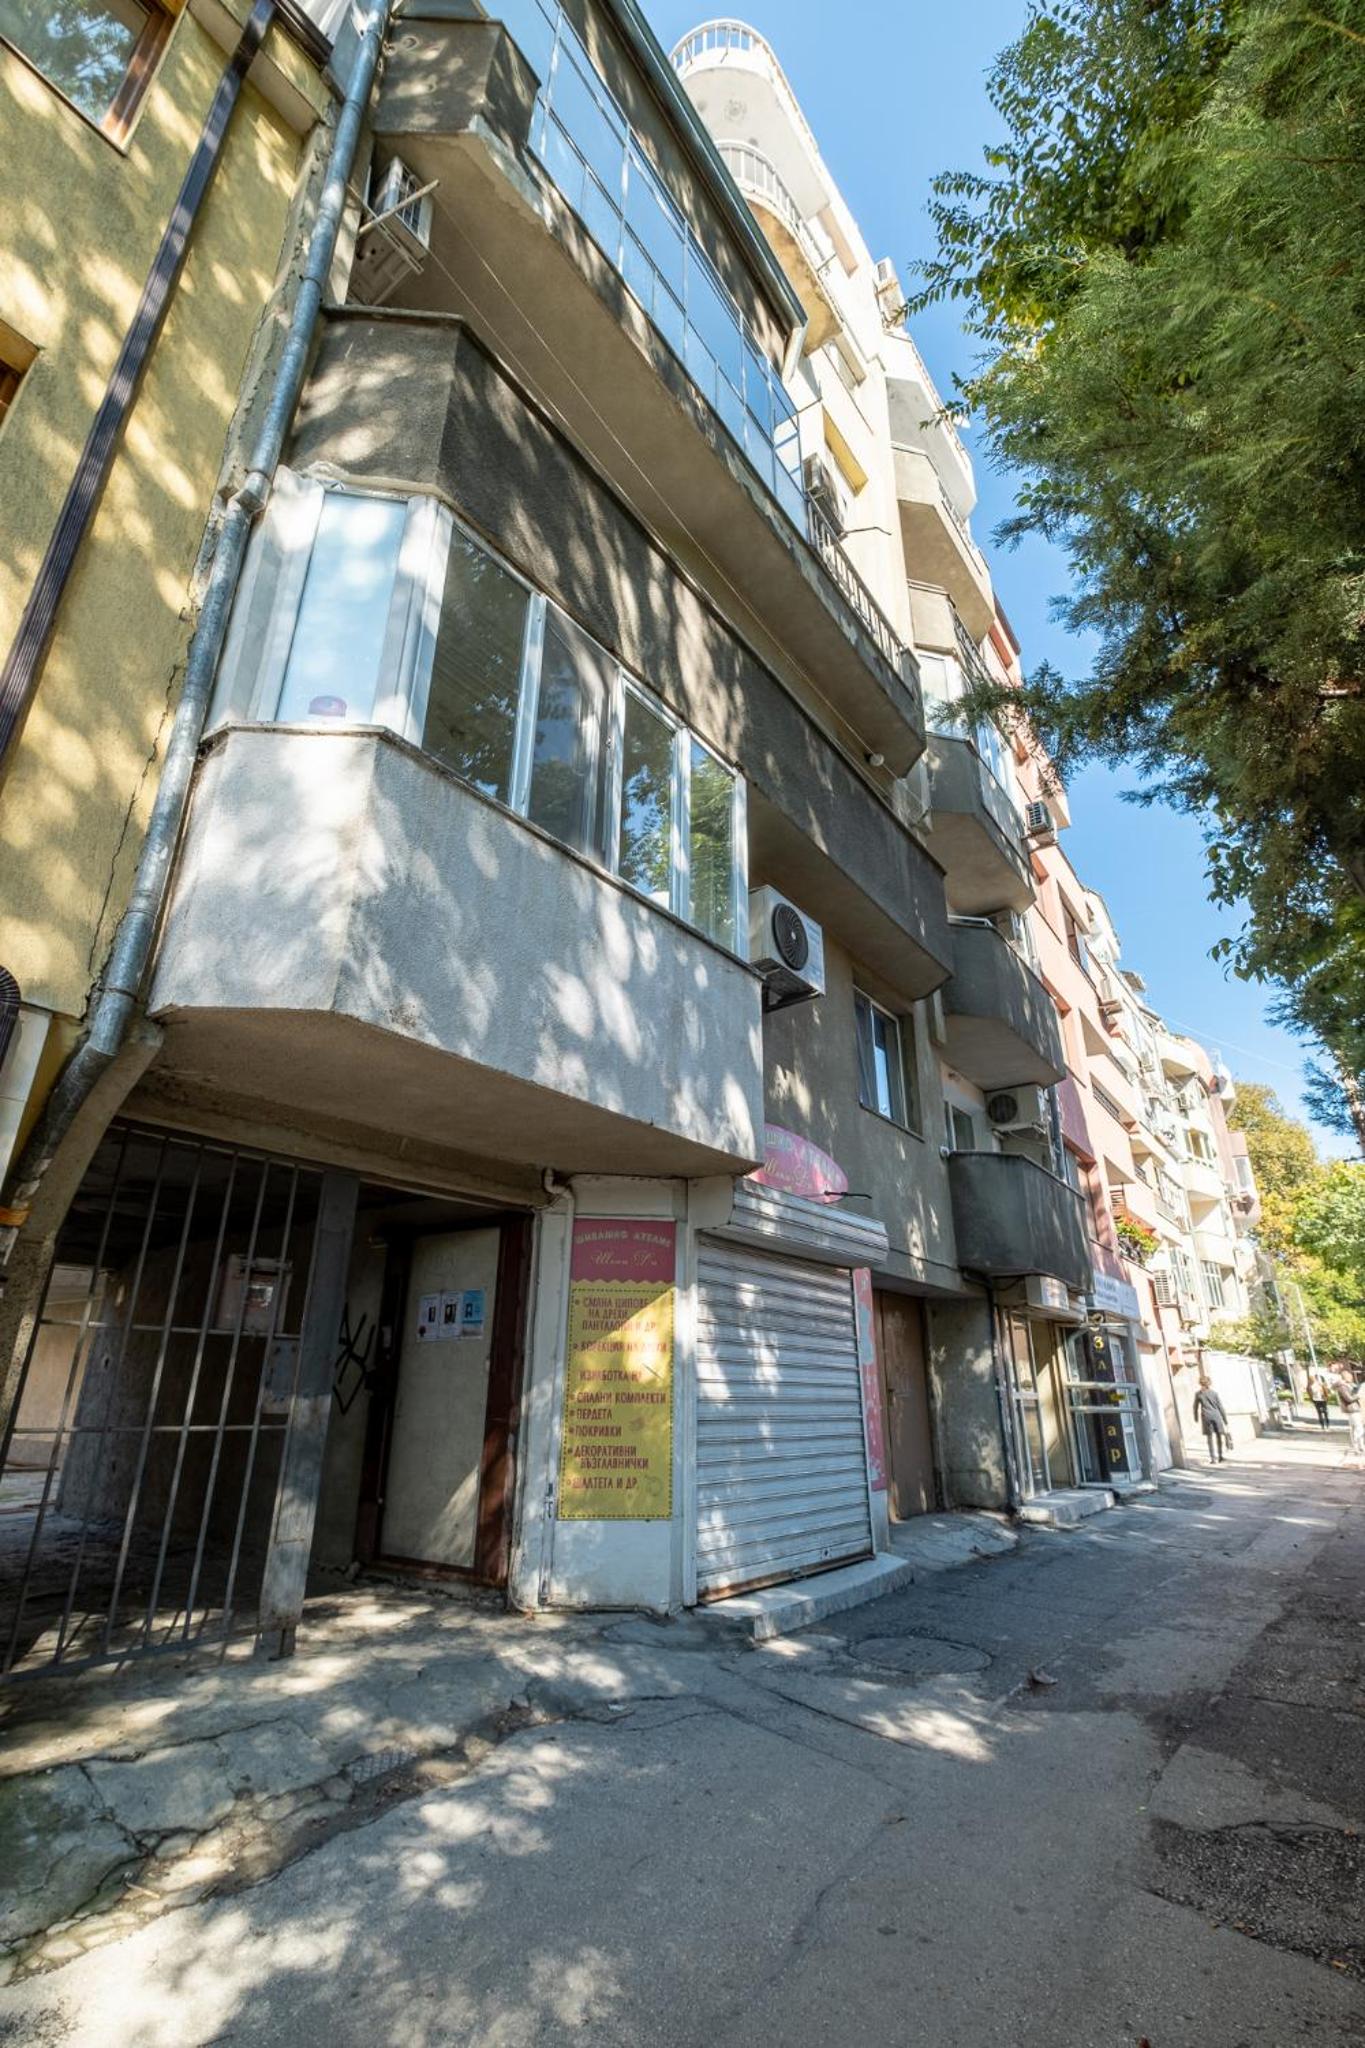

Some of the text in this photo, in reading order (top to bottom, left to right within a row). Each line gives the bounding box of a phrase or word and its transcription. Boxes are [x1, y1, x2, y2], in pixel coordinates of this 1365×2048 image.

[577, 1391, 666, 1404] СПАЛНИ КОМПЛЕКТИ
[576, 1408, 612, 1420] ПЕРДЕТА
[575, 1425, 622, 1437] ПОКРИВКИ
[573, 1445, 637, 1457] ДЕКОРАТИВНИ
[580, 1458, 649, 1469] ВЪЗГЛАВНИЧКИ
[572, 1476, 613, 1489] ШАЛТЕТА
[616, 1477, 623, 1489] И
